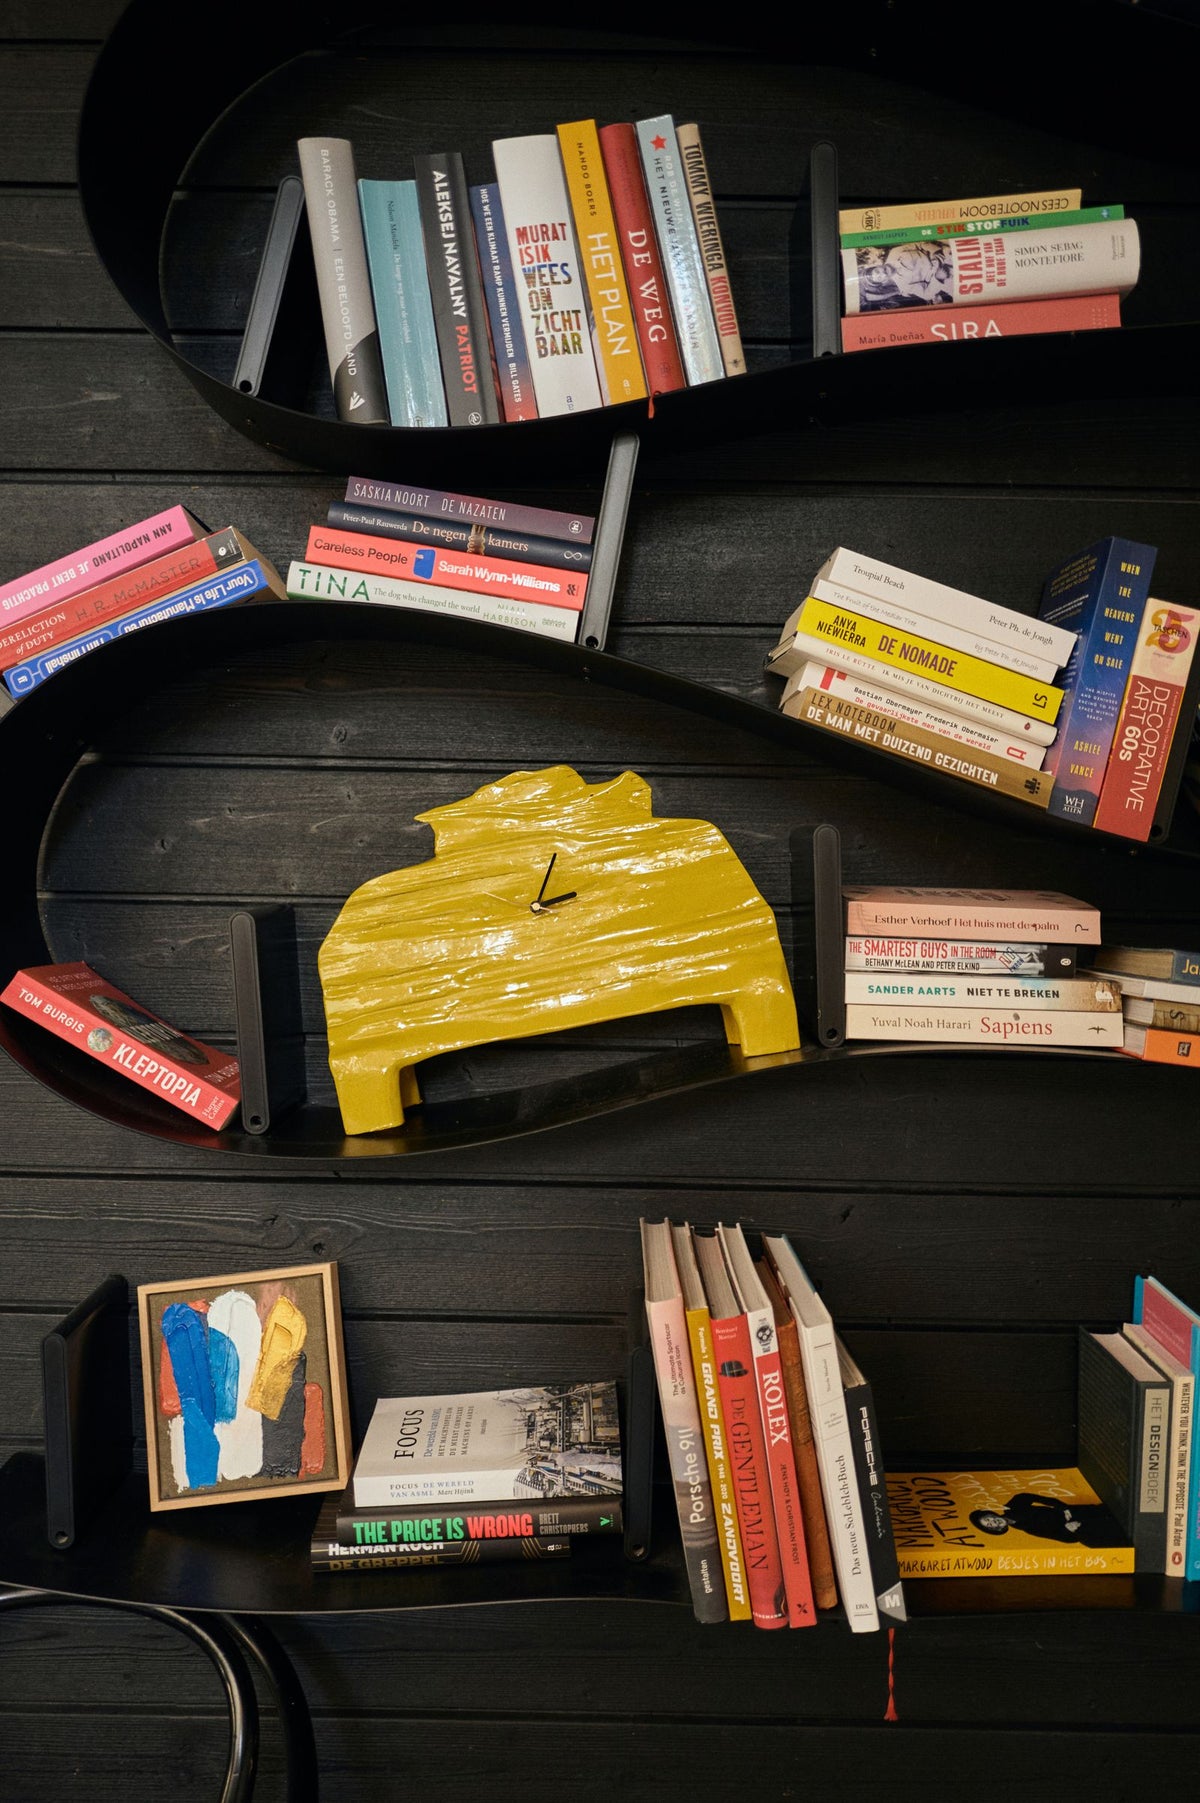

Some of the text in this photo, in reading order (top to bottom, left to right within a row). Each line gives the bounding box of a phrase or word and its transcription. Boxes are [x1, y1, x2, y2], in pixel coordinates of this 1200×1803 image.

[660, 186, 676, 235] NIEUWE
[959, 198, 1069, 217] CEES NOOTEBOOM
[515, 223, 567, 246] MURAT
[577, 142, 631, 355] NANDO BOERS HET PLAN
[684, 143, 738, 337] TOMMY WIERINGA KONVOOI
[1014, 241, 1084, 256] SIMON SEBAG
[320, 149, 357, 376] BARACK OBAMA EEN BELOOFD LAND
[519, 244, 552, 266] ISIK
[955, 238, 983, 295] STALIN
[1014, 253, 1085, 268] MONTEFIORE
[432, 171, 477, 394] ALEKSEJ NAVALNY PATRIOT
[522, 263, 573, 289] WEES
[628, 229, 667, 343] DE WEG
[531, 310, 581, 336] ZICHT
[859, 319, 1003, 345] María Dueñas SIRA
[535, 332, 583, 359] BAAR
[353, 483, 506, 521] SASKIA NOORT DE NAZATEN
[342, 513, 529, 552] Peter-Paul Rauwerda De negen kamers
[2, 522, 172, 610] ANN NAPOLITANO JE BENT PRACHTIG
[314, 538, 561, 593] Careless People Sarah Wynn-Williams
[1120, 561, 1141, 576] WHEN
[226, 573, 253, 591] Your
[299, 569, 481, 613] TINA The dog who world
[1118, 586, 1132, 598] THE
[25, 557, 201, 650] DUTY McMASTER
[853, 564, 1053, 646] Troupial Beach Peter de Jongh
[1104, 607, 1135, 623] HEAVENS
[482, 612, 537, 628] HARBISON
[816, 621, 866, 647] NIEWIERRA
[833, 615, 857, 632] ANYA
[1153, 624, 1188, 639] TASCHEN
[1104, 631, 1124, 645] WENT
[878, 635, 958, 677] DE NOMADE
[811, 693, 897, 733] LEX NOTEBOOM
[854, 686, 999, 743] Bastian Obermayer Frederik Obermaier
[1119, 681, 1152, 762] ART 60s
[806, 706, 998, 786] DE MAN MET DUIZEND GEZICHTEN
[966, 737, 992, 751] wereld
[1073, 740, 1101, 756] ASHLEE
[1125, 686, 1170, 812] DECORATIVE
[1070, 764, 1094, 778] VANCE
[874, 914, 1060, 932] Esther Verhoef Het huis met palm
[849, 939, 997, 959] THE SMARTEST GUYS IN THE ROOM
[865, 958, 980, 971] BETHANY McLEAN AND PETER ELKIND
[867, 985, 1060, 999] SANDER AARTS NIET TE BREKEN
[871, 1015, 1053, 1039] Yuval Noah Harari Sapiens
[18, 989, 43, 1009] TOM
[42, 1004, 85, 1034] BURGIS
[112, 1043, 202, 1107] KLEPTOPIA
[763, 1370, 789, 1447] ROLEX
[394, 1409, 424, 1459] FOCUS
[678, 1427, 695, 1450] 911
[859, 1406, 878, 1486] PORSCHE
[1175, 1382, 1191, 1510] WHATEVER OPPOSITE
[1146, 1397, 1163, 1504] HET DESIGNBOEK
[437, 1480, 474, 1488] WERELD
[684, 1452, 706, 1524] Porsche
[701, 1363, 745, 1605] GRAND PRIX ZANDVOORT
[731, 1422, 769, 1570] GENTLEMAN
[352, 1513, 533, 1545] THE PRICE IS WRONG
[539, 1512, 560, 1525] BRETT
[539, 1523, 589, 1535] CHRISTOPHERS
[786, 1505, 798, 1543] CHRISTIAN
[329, 1560, 353, 1571] DE
[850, 1530, 862, 1576] Das neue
[898, 1556, 1081, 1573] MARGARET ATWOOD BESJES HET
[700, 1559, 713, 1594] gestalten
